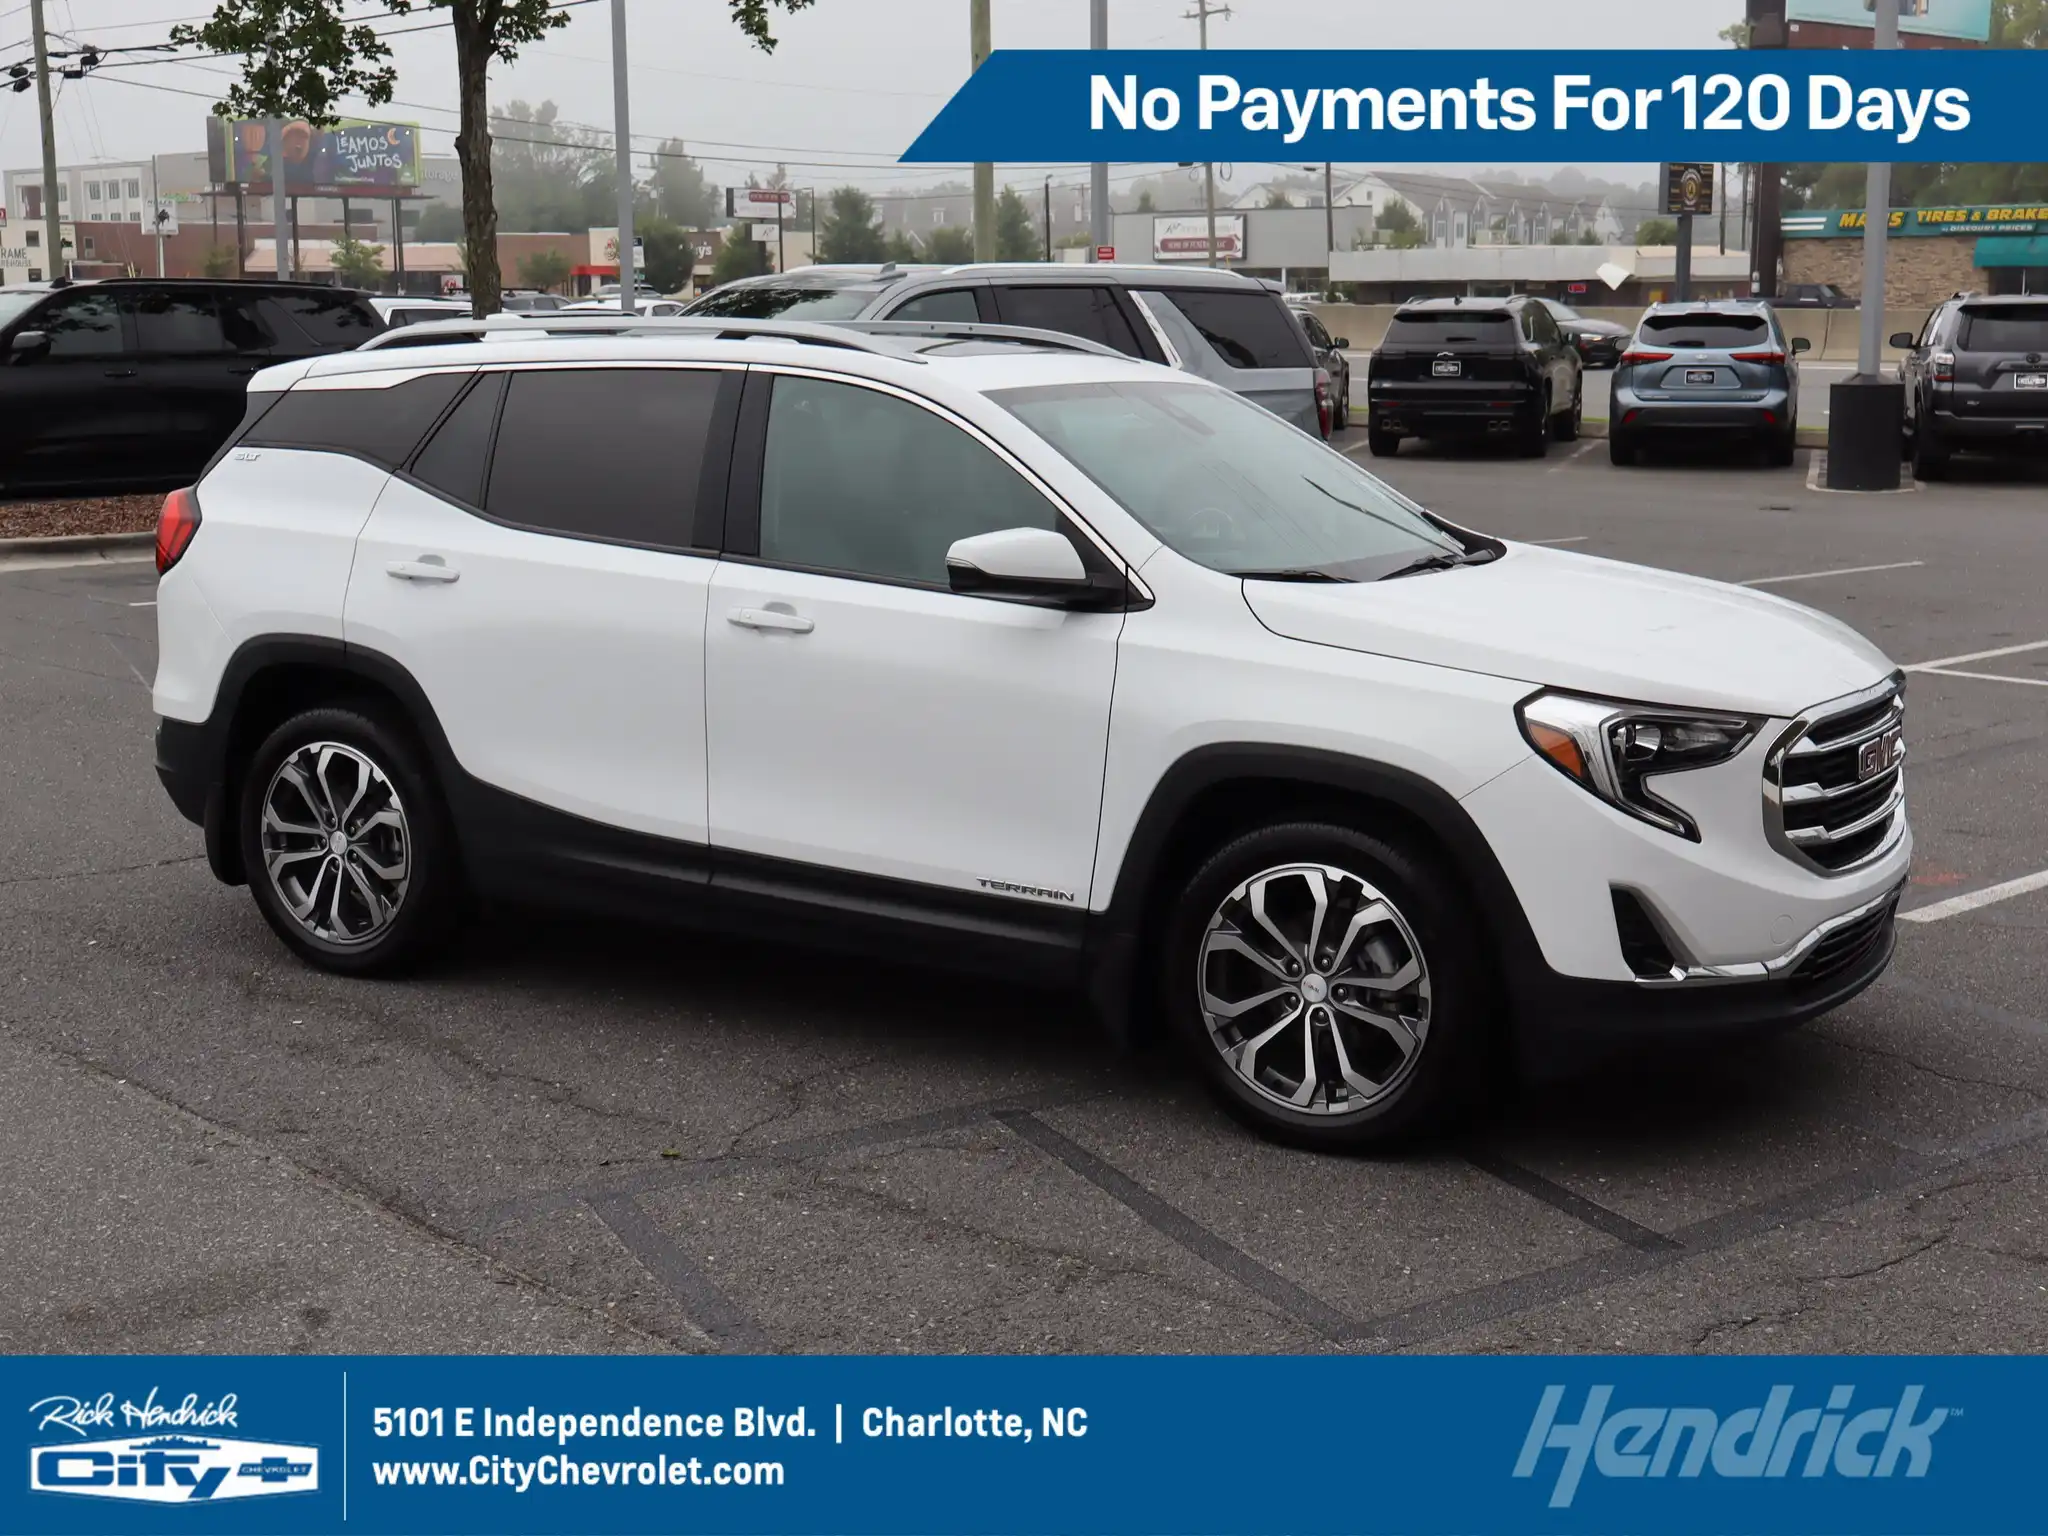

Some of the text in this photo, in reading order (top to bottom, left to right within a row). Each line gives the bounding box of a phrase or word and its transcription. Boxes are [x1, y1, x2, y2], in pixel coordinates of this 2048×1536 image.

[336, 135, 388, 154] LEAMOS
[345, 153, 402, 173] JUNTOS
[1917, 210, 1968, 223] TIRES
[1998, 223, 2033, 231] PRICES
[234, 451, 261, 462] SLT
[976, 876, 1075, 902] TERRAIN
